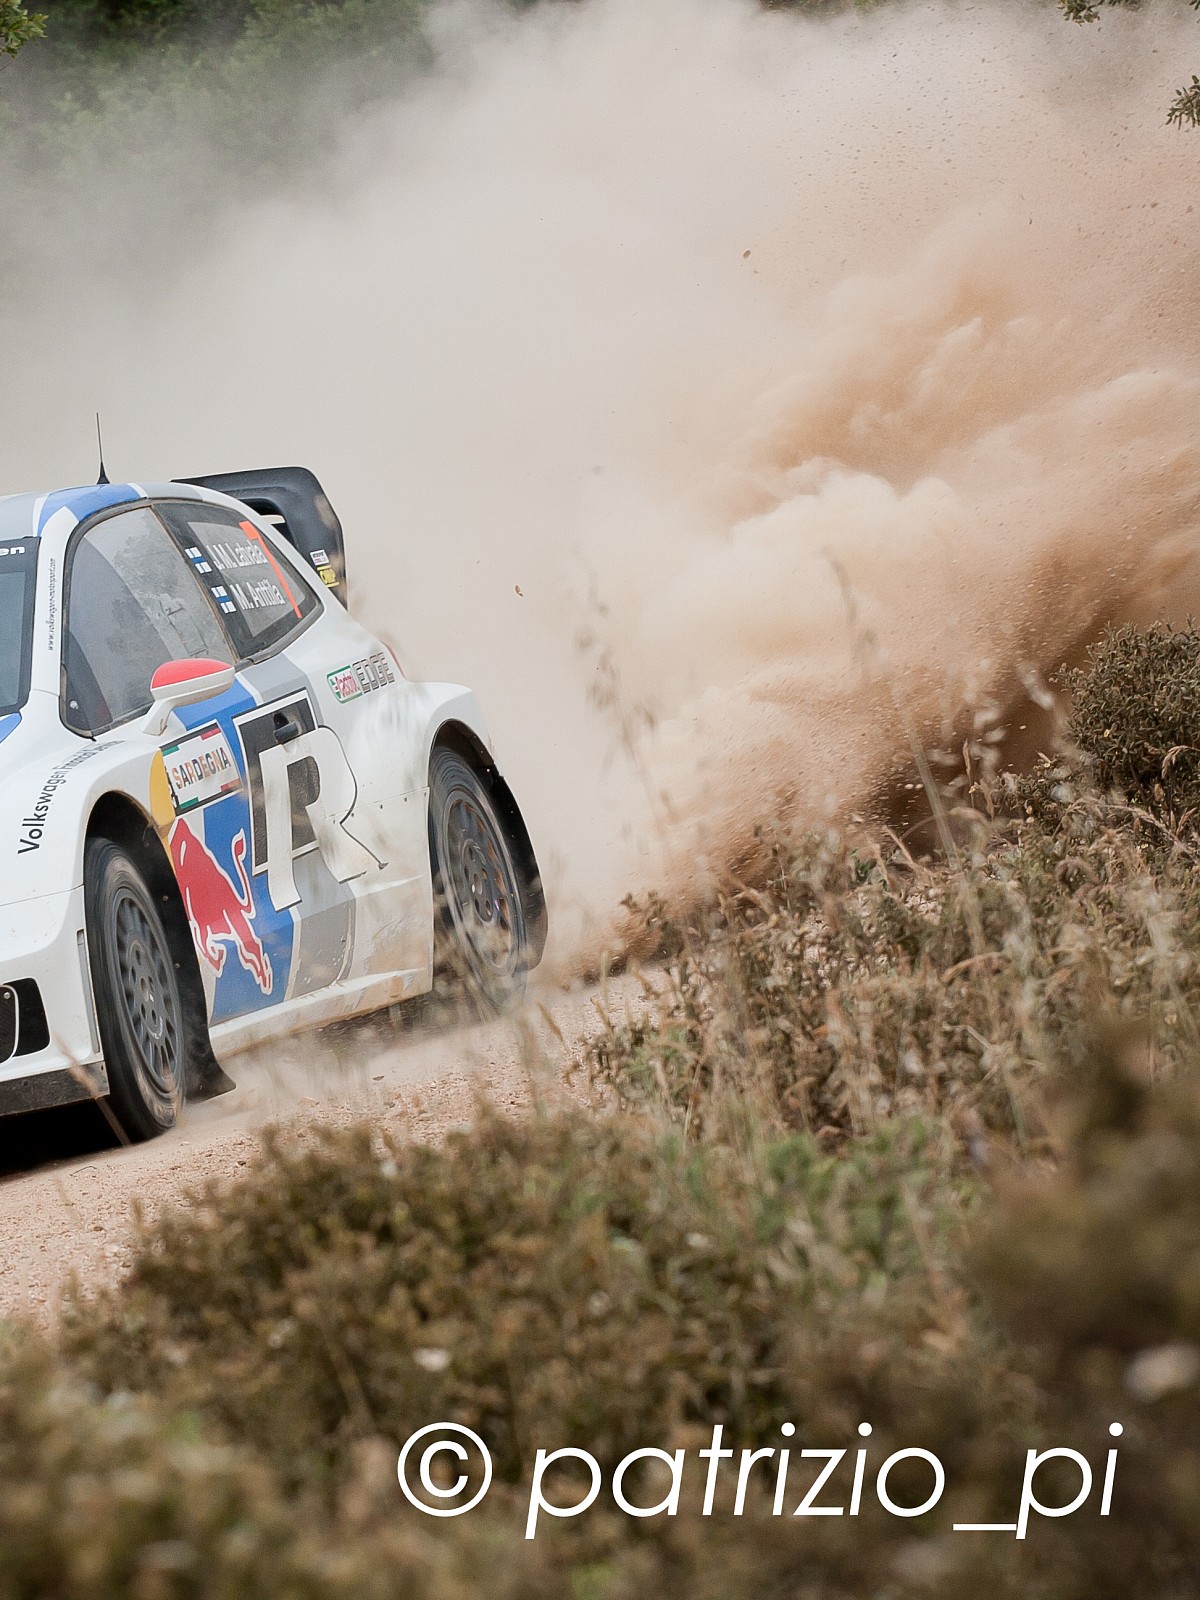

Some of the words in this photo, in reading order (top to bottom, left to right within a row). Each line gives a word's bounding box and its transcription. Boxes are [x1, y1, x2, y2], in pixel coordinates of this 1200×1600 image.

[352, 651, 395, 694] EDGE
[171, 747, 232, 790] SARDEGNA
[17, 770, 69, 855] Volkswagen
